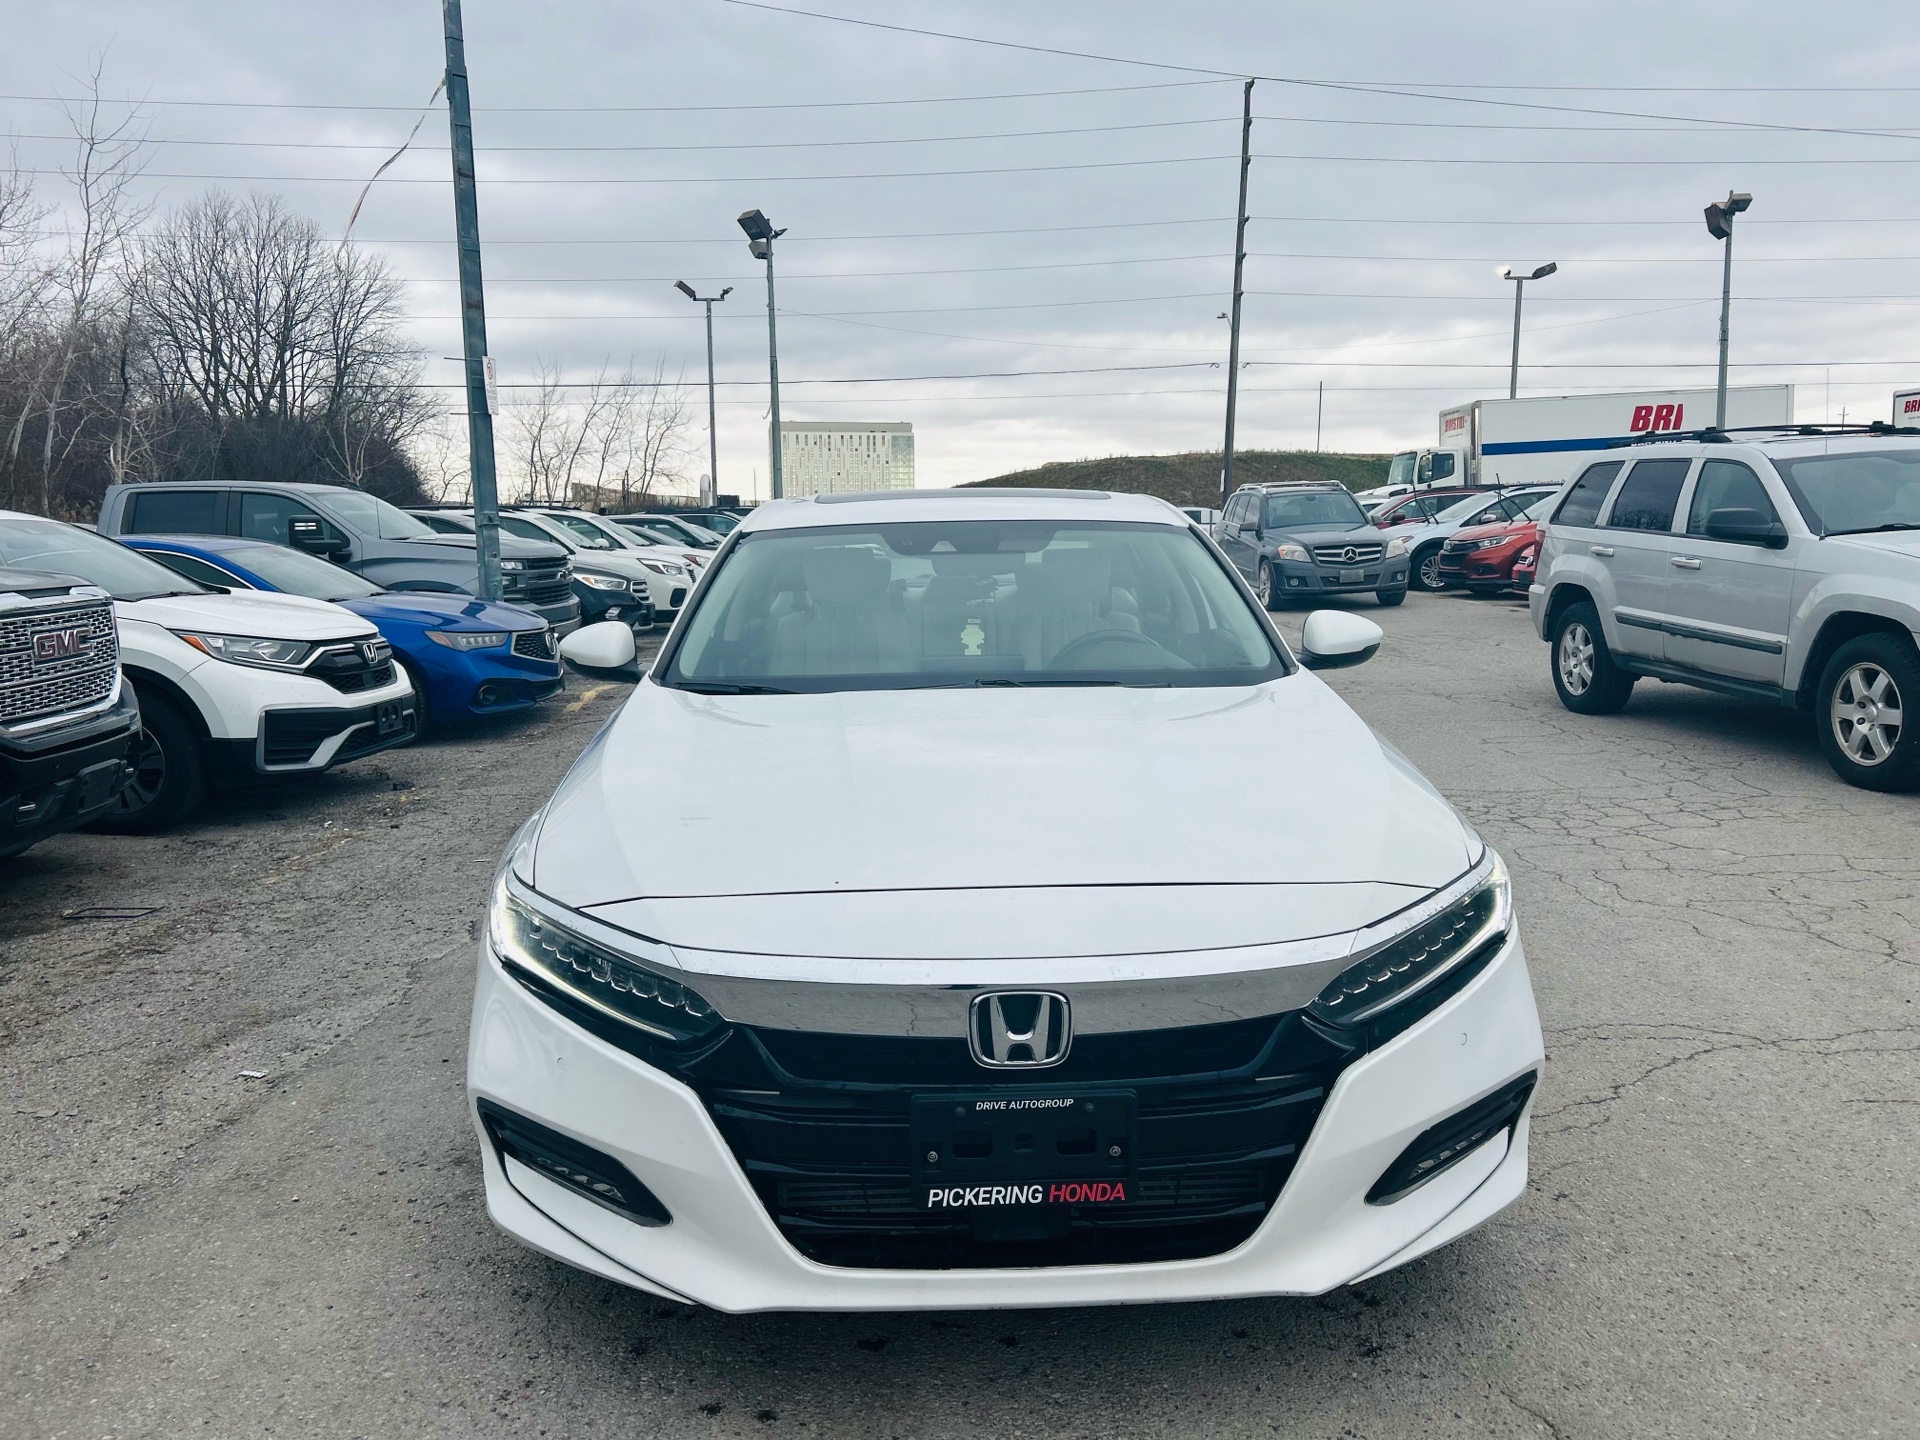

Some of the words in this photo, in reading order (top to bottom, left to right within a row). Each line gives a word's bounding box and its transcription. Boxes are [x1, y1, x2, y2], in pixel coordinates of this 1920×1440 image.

[1630, 404, 1683, 432] BRI
[33, 627, 92, 660] GMC
[975, 1101, 1007, 1110] DRIVE
[1008, 1098, 1074, 1110] AUTOGROUP
[927, 1185, 1043, 1208] PICKERING
[1049, 1182, 1126, 1203] HONDA
